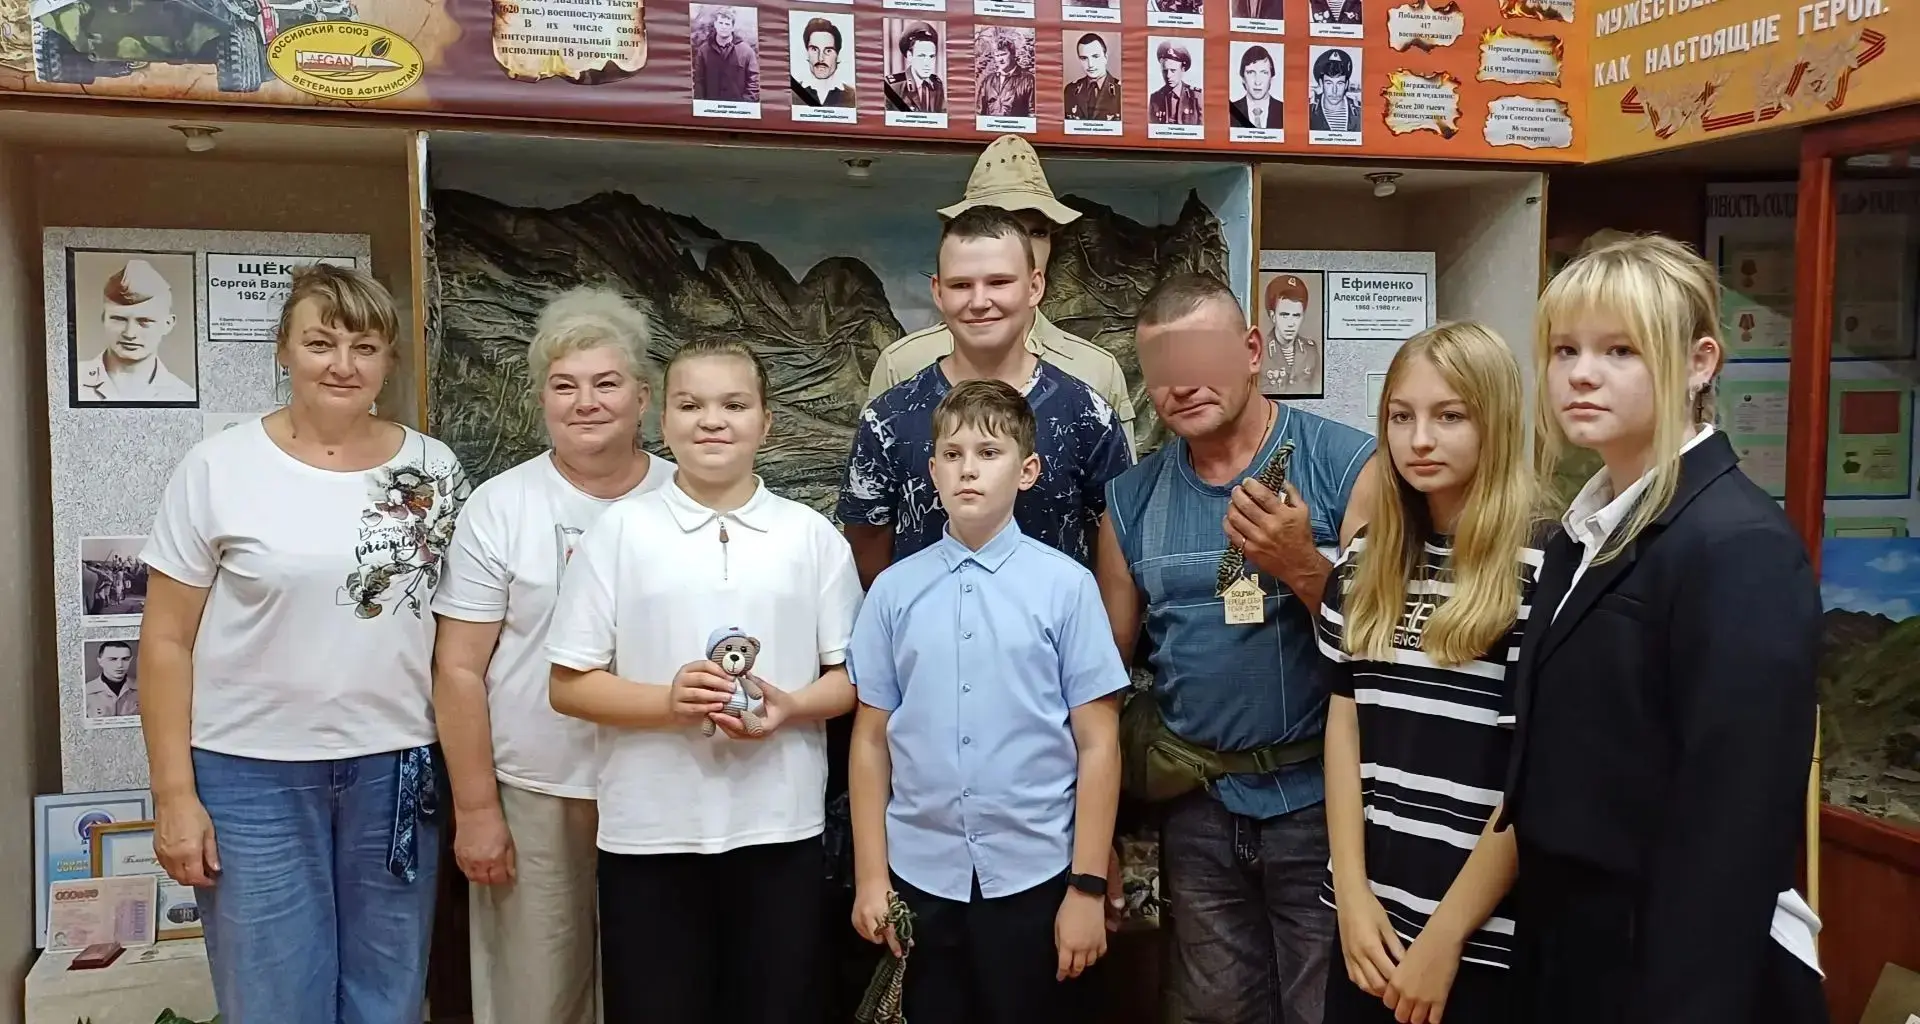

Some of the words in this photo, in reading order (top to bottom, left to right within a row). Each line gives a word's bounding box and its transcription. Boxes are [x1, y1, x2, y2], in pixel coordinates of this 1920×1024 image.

[1596, 0, 1716, 37] МУЖЕСТВ
[524, 20, 532, 28] В
[573, 24, 603, 32] числе
[616, 24, 641, 34] свой
[272, 25, 334, 59] РОССИЙСКИЙ
[339, 26, 369, 37] СОЮЗ
[501, 32, 611, 46] интернациональный
[618, 40, 641, 48] долг
[502, 47, 560, 56] исполнили
[563, 48, 574, 57] 18
[1594, 55, 1631, 88] КАК
[1645, 14, 1781, 74] НАСТОЯЩИЕ
[292, 74, 354, 96] ВЕТЕРАНОВ
[358, 62, 419, 96] АФГАНИСТАНА
[238, 262, 292, 276] ЩЁК
[211, 278, 256, 289] Сергей
[1341, 278, 1414, 291] Ефименко
[237, 292, 266, 300] 1962
[1334, 293, 1370, 302] Алексей
[1373, 294, 1422, 303] Георгиевич
